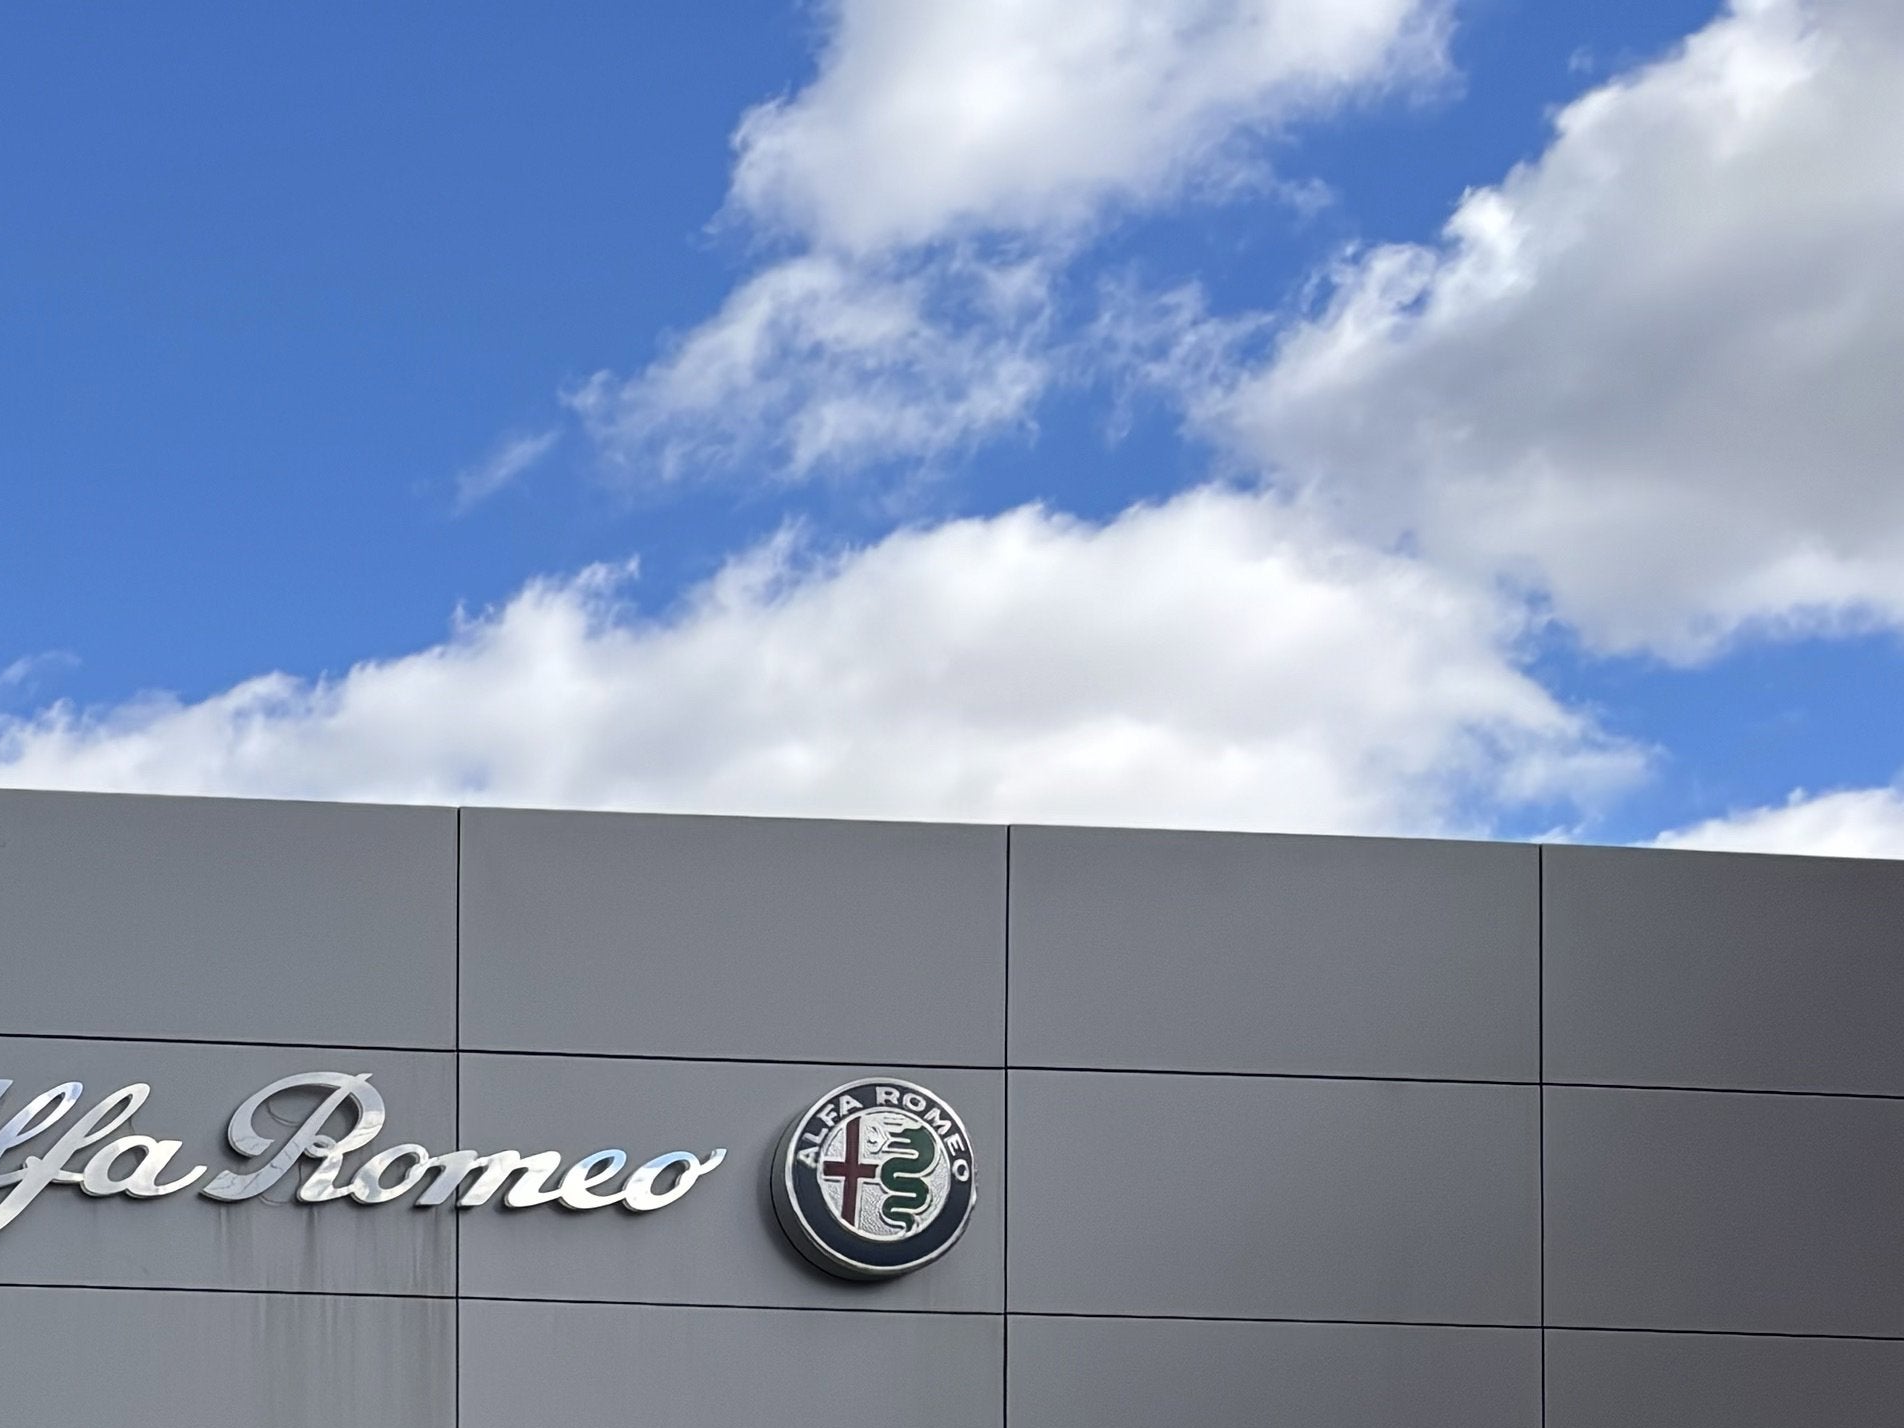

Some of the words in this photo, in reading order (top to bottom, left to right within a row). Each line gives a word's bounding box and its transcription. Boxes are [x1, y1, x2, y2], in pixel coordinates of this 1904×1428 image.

[200, 1070, 727, 1214] Romeo
[796, 1093, 864, 1170] ALFA
[875, 1085, 970, 1183] ROMEO
